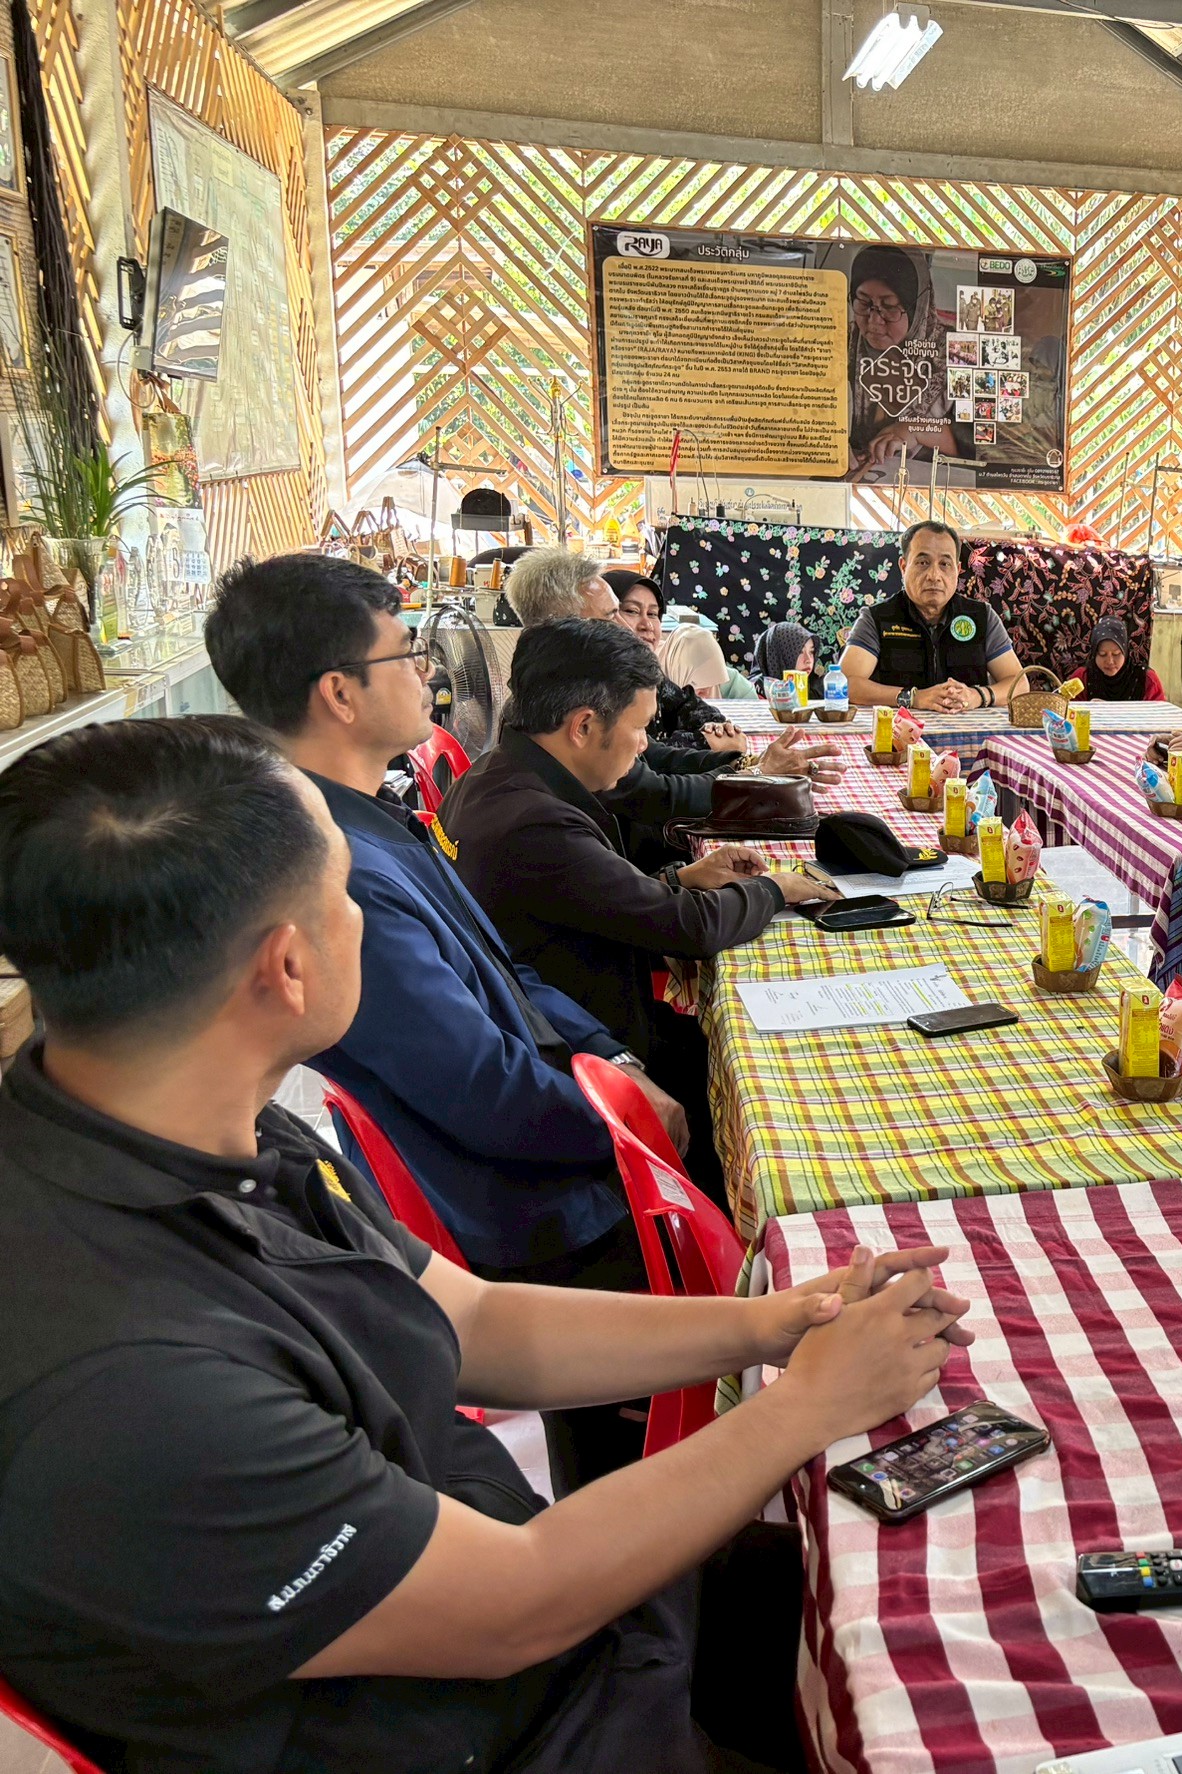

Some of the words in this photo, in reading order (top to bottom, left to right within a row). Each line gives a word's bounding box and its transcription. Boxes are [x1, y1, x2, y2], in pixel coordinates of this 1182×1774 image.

[698, 245, 750, 261] ประวัติกลุ่ม
[990, 261, 1010, 270] BEDO
[905, 340, 936, 349] เครือข่าย
[902, 348, 938, 357] ภูมิปัญญา
[860, 357, 932, 385] กระจูด
[869, 383, 922, 404] รายา
